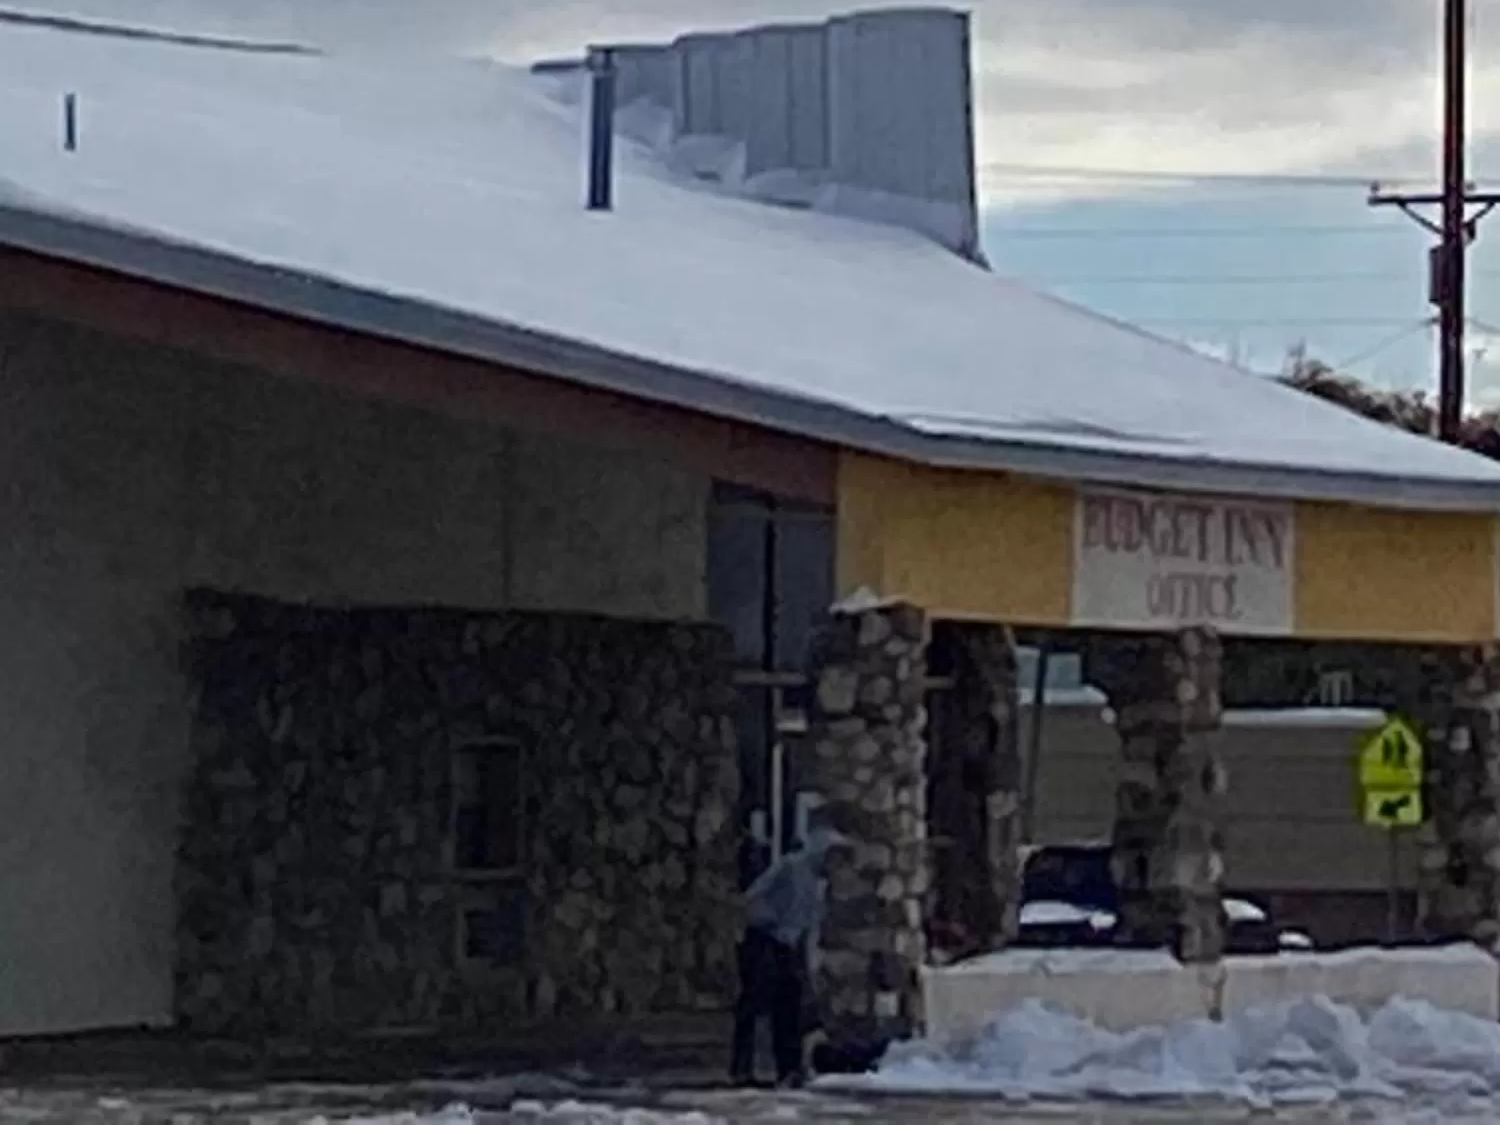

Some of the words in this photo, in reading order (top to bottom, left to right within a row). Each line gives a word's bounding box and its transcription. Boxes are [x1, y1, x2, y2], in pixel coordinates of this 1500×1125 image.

[1083, 493, 1214, 563] BUDGET
[1223, 507, 1288, 568] INN
[1147, 571, 1243, 621] OFFICE
